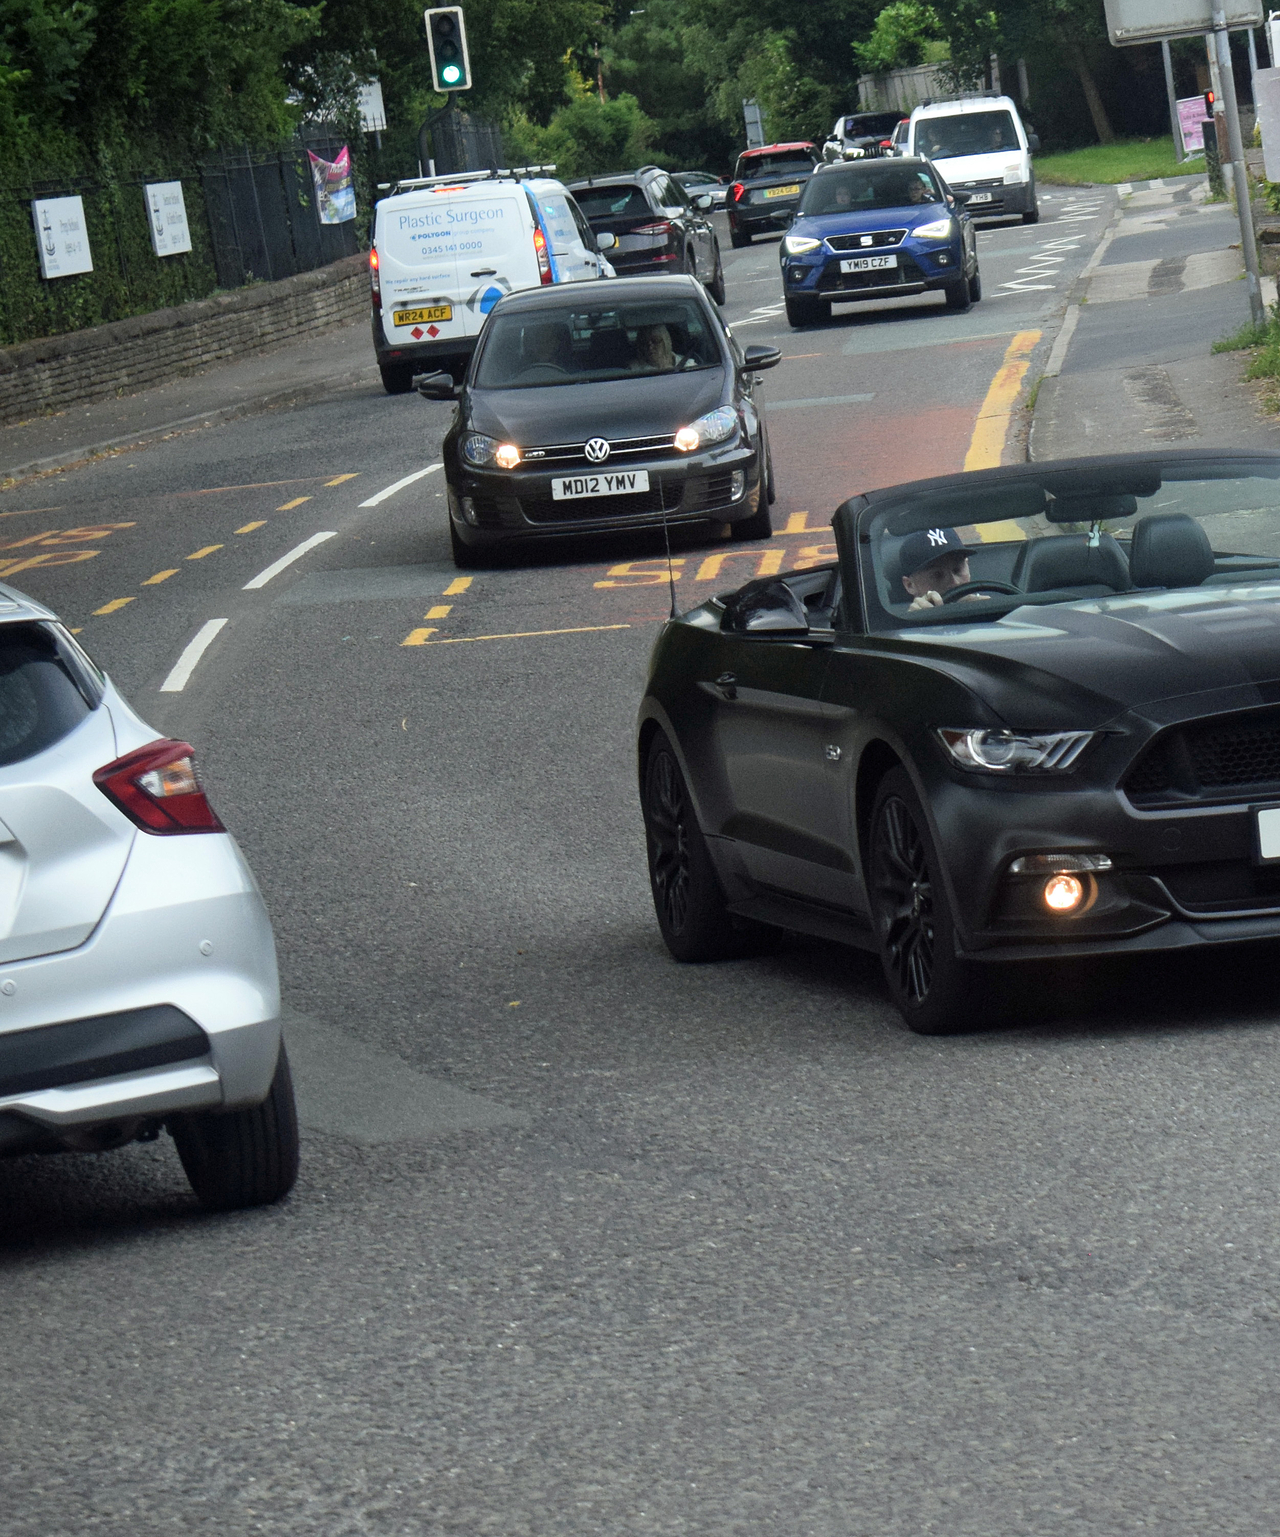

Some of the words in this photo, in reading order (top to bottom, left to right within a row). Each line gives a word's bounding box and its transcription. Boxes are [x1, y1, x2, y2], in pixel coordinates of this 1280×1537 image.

[399, 212, 442, 230] Plastic
[446, 208, 504, 225] Surgeon
[417, 231, 451, 240] POLYGON
[421, 245, 443, 255] 0345
[445, 244, 457, 252] 141
[459, 240, 483, 250] 0000
[846, 259, 869, 270] YM19
[871, 256, 890, 268] CZF
[397, 311, 424, 323] WR24
[427, 307, 447, 319] ACF
[562, 477, 600, 496] MD12
[604, 473, 636, 491] YMV
